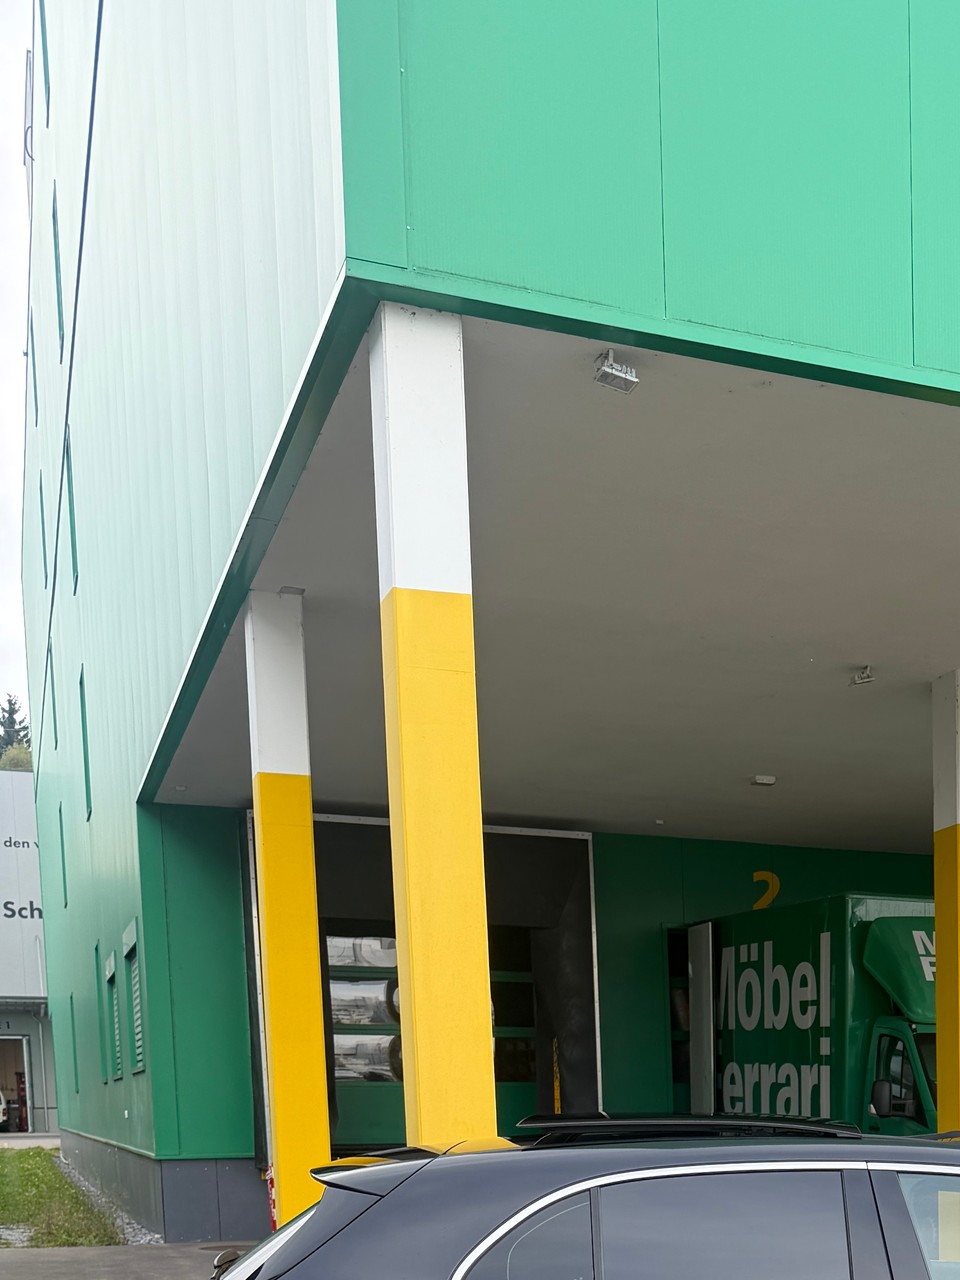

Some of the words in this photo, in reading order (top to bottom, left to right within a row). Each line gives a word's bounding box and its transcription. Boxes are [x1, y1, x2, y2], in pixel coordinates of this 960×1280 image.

[4, 837, 30, 848] den
[752, 871, 780, 910] 2
[722, 1037, 831, 1119] errari
